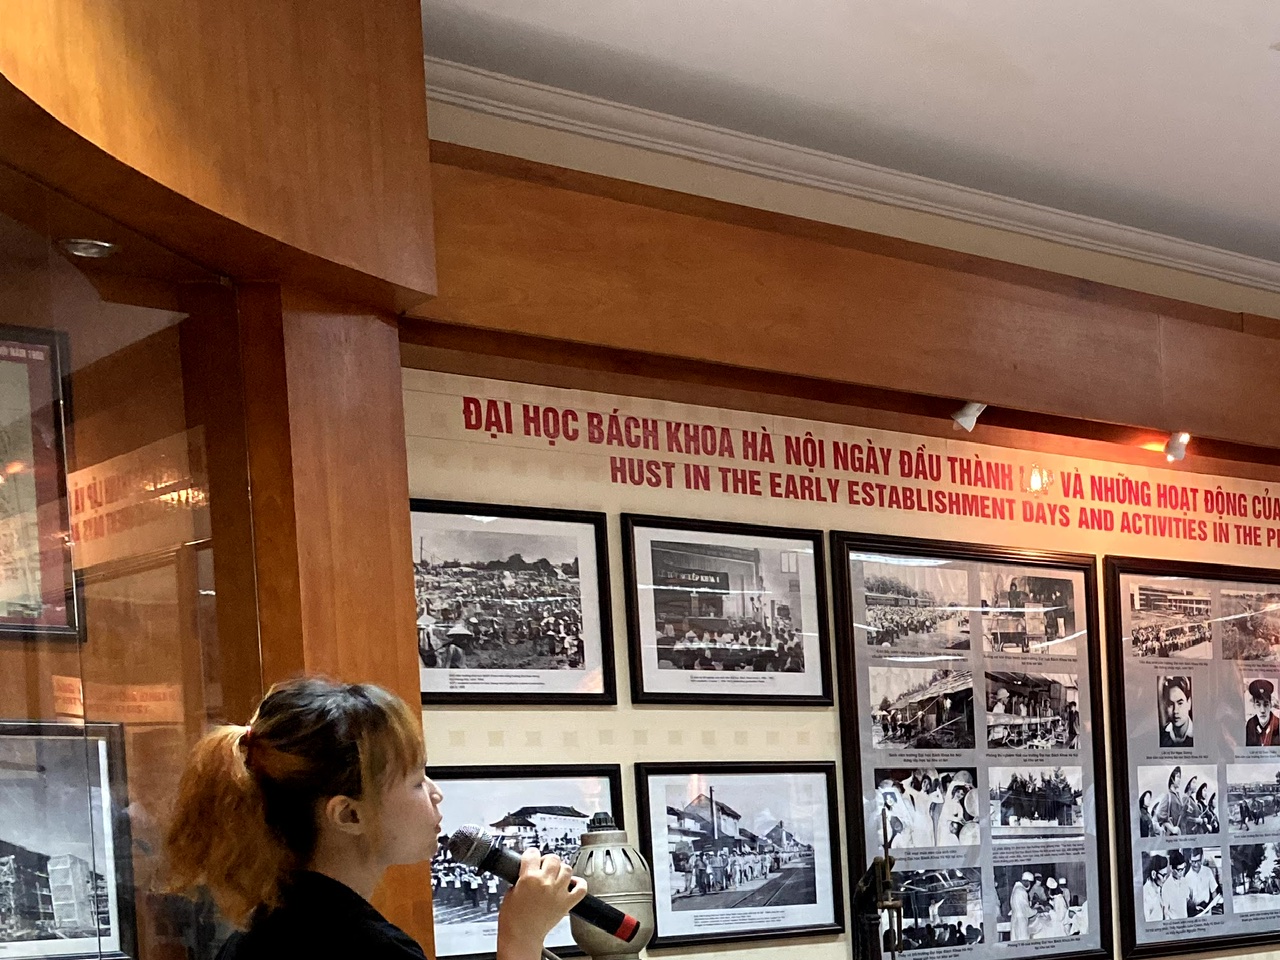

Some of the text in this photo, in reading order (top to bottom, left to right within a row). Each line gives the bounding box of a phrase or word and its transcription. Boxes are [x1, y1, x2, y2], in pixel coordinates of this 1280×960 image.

[463, 396, 513, 438] ĐẠI
[522, 403, 579, 446] HỌC
[587, 408, 660, 451] BÁCH
[665, 421, 735, 459] KHOA
[742, 426, 775, 463] HÀ
[784, 431, 825, 472] NỘI
[833, 438, 891, 476] NGÀY
[899, 444, 941, 482] ĐẦU
[947, 453, 1014, 491] THÀNH
[1090, 472, 1151, 507] NHỮNG
[1156, 483, 1199, 515] HOẠT
[1204, 486, 1248, 520] ĐỘNG
[609, 456, 675, 489] HUST
[684, 463, 711, 491] IN
[718, 467, 762, 496] THE
[769, 472, 840, 503] EARLY
[847, 480, 1016, 521] ESTABLISHMENT
[1022, 501, 1070, 528] DAYS
[1078, 507, 1115, 532] AND
[1120, 512, 1208, 542] ACTIVITIES
[1213, 525, 1230, 544] IN
[1234, 524, 1262, 547] THE
